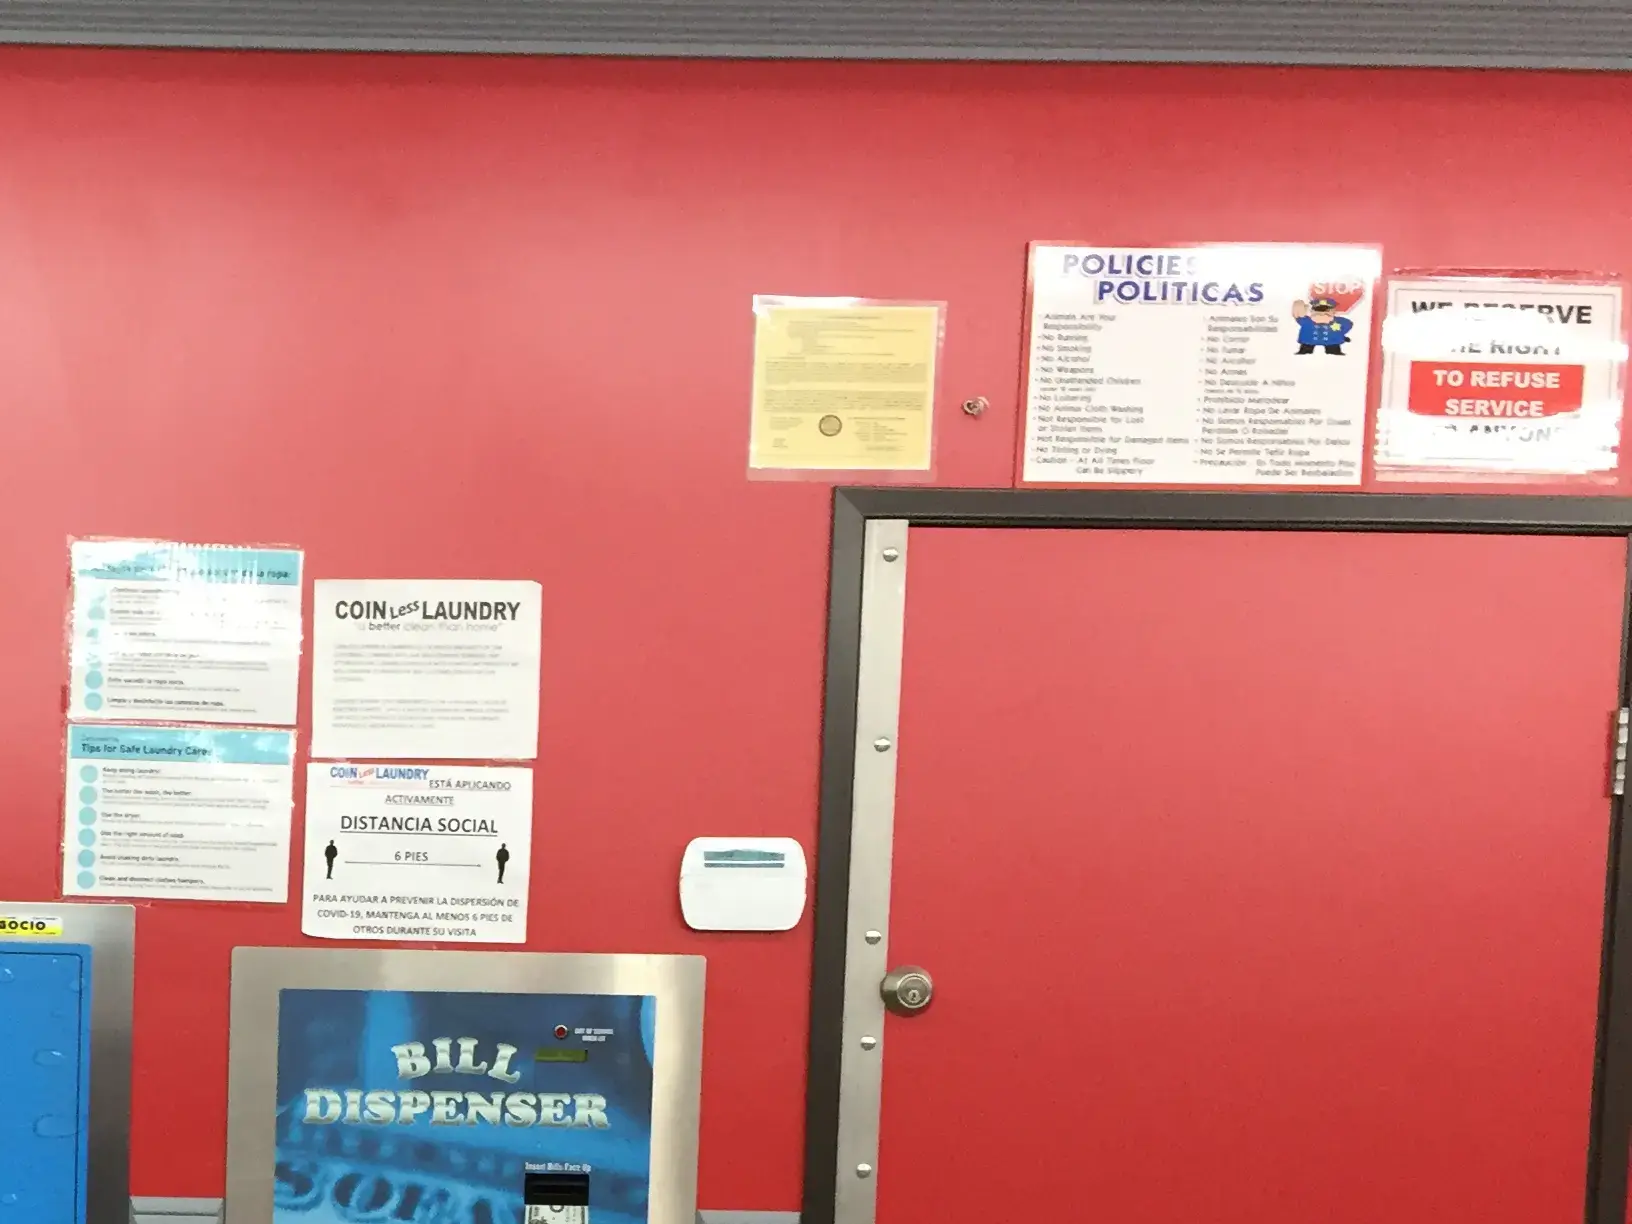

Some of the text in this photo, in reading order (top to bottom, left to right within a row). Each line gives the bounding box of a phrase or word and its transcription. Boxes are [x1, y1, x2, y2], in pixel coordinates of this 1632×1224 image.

[1098, 280, 1264, 302] POLITICAS
[1314, 280, 1364, 295] STOP
[1433, 370, 1561, 389] TO REFUSE
[1445, 398, 1545, 418] SERVICE
[335, 600, 521, 621] COIN Less LAUNDRY
[368, 621, 401, 631] better
[81, 743, 101, 754] Tips
[103, 743, 117, 753] for
[119, 744, 141, 754] Safe
[143, 745, 182, 757] Laundry
[330, 766, 358, 778] COIN
[376, 768, 430, 780] LAUNDRY
[429, 779, 452, 789] ESTÁ
[455, 780, 512, 791] APLICANDO
[385, 794, 455, 805] ACTIVAMENTE
[340, 815, 499, 834] DISTANCIA SOCIAL
[394, 851, 429, 862] 6 PIES
[313, 894, 519, 908] PARA AYUDAR A PREVENIR LA DISPERSIÓN DE
[317, 909, 513, 923] COVID-19, MANTENGA AL MENOS 6 PIES DE
[353, 925, 477, 936] OTROS DURANTE SU VISITA
[390, 1036, 521, 1083] BILL
[302, 1088, 612, 1130] DISPENSER
[525, 1162, 592, 1174] Insert Bills Face Up
